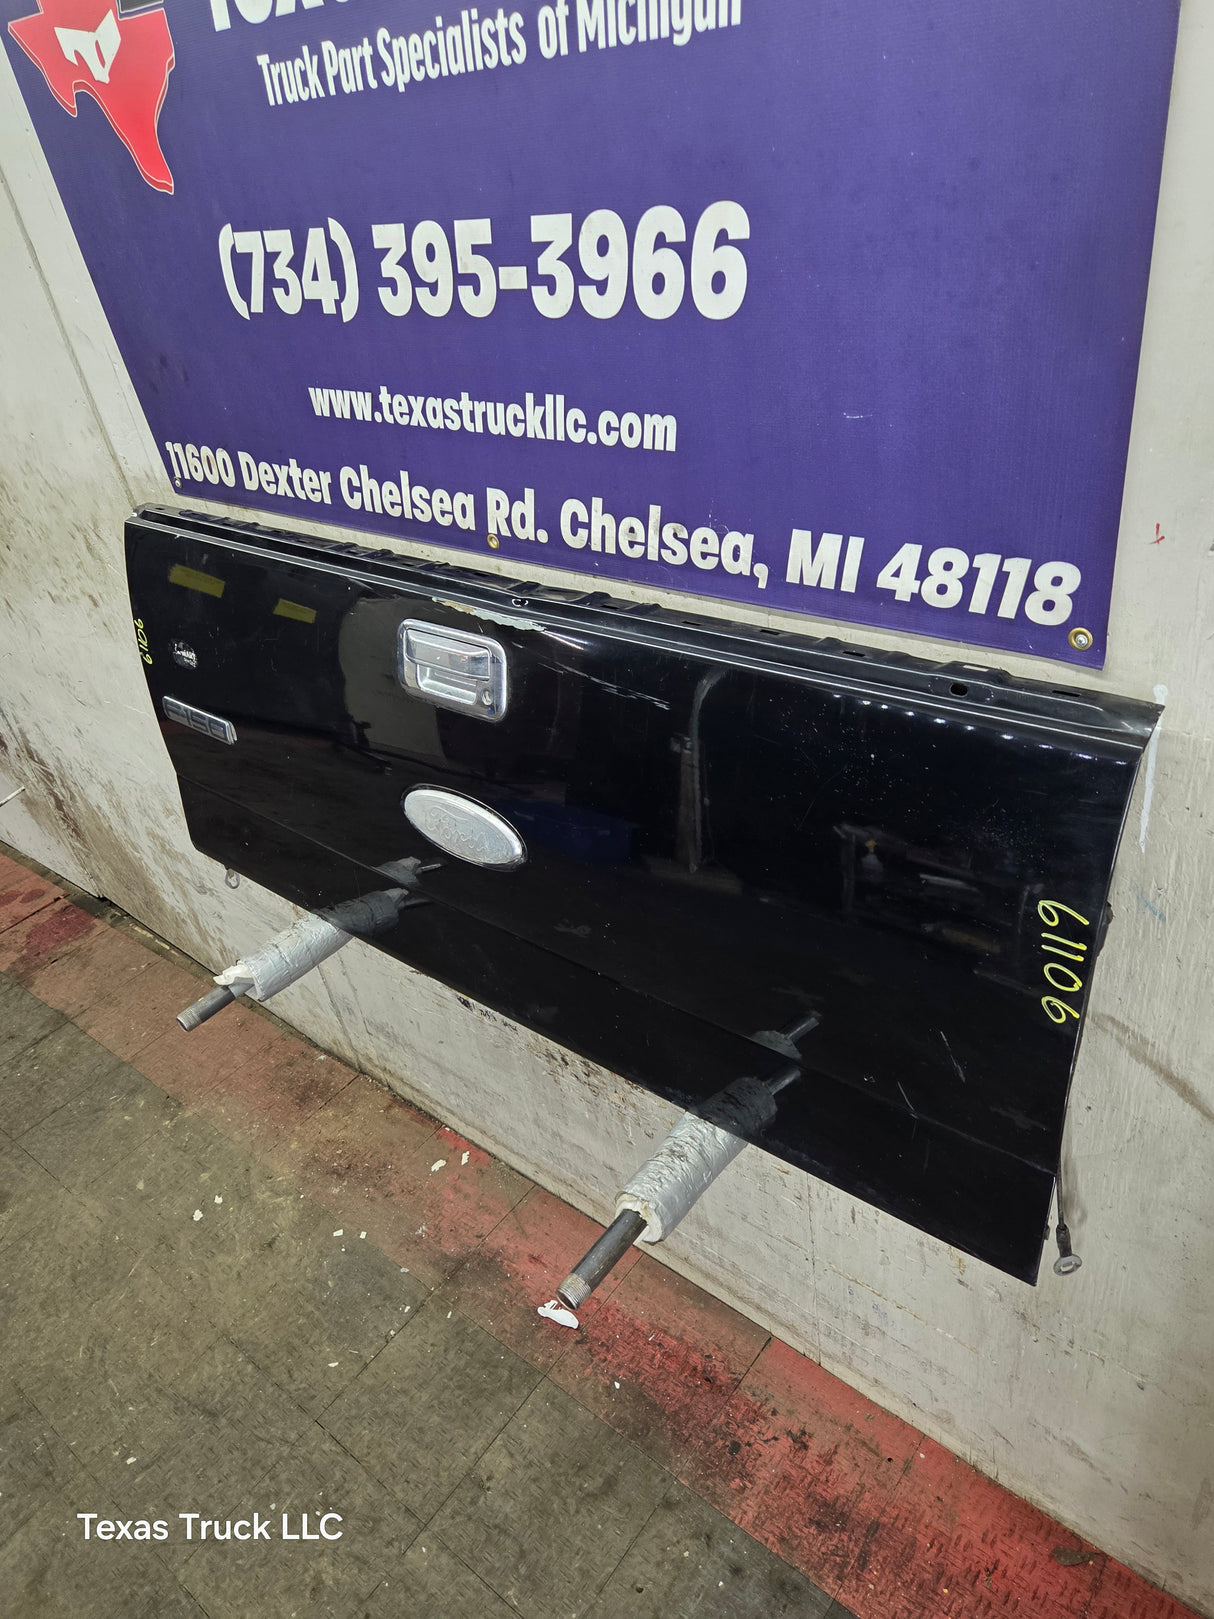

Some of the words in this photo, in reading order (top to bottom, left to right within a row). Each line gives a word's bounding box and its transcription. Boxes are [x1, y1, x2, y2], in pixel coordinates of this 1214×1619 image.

[256, 44, 326, 107] Truck
[320, 39, 379, 97] Part
[376, 7, 527, 93] Specialists
[537, 0, 569, 60] of
[218, 216, 360, 323] (734)
[370, 200, 751, 321] 395-3966
[307, 385, 678, 452] www.texastruckllc.com
[165, 441, 236, 488] 11600
[237, 450, 332, 505] Dexter
[339, 464, 476, 531] Chelsea
[486, 482, 549, 544] Rd.
[560, 496, 769, 590] Chelsea,
[785, 528, 865, 594] MI
[876, 542, 1082, 626] 48118
